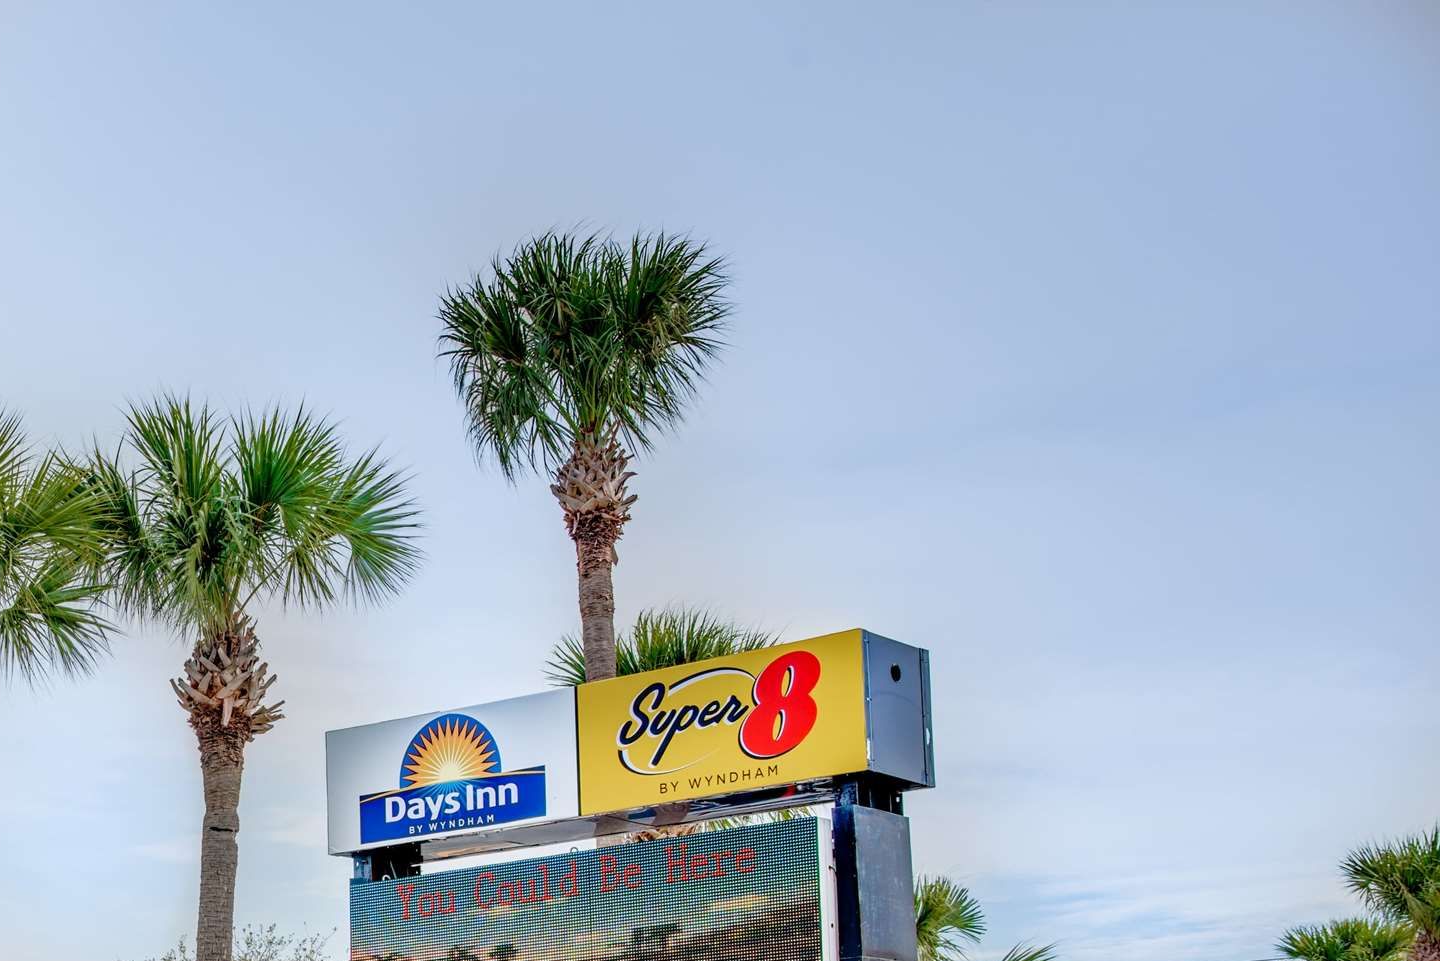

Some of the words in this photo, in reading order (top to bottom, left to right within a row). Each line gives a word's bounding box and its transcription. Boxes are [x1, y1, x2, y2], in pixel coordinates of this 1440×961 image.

[616, 682, 749, 768] Super
[738, 650, 822, 760] 8
[659, 781, 679, 794] BY
[688, 764, 779, 789] WYNDHAM
[384, 791, 459, 823] Days
[466, 782, 518, 810] Inn
[408, 824, 423, 835] BY
[429, 814, 495, 831] WYNDHAM
[395, 883, 455, 920] You
[474, 860, 579, 909] Could
[599, 853, 641, 893] Be
[663, 843, 756, 884] Here
